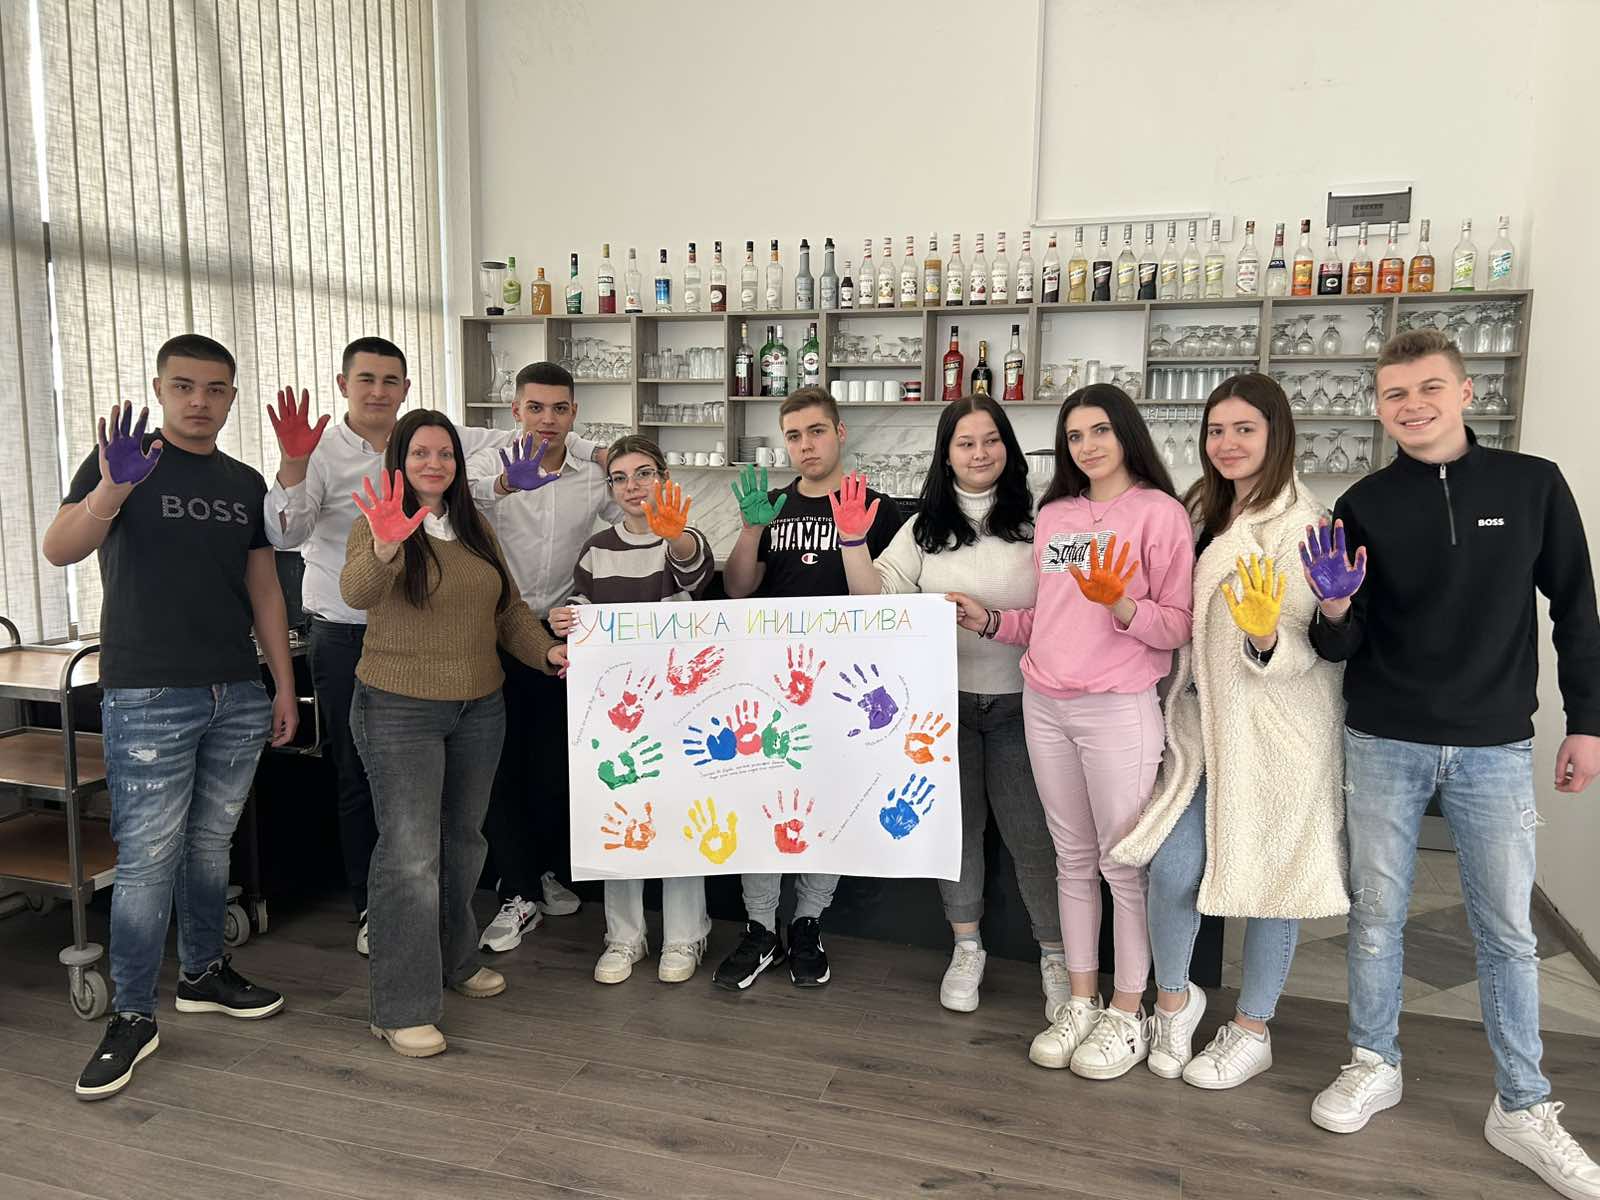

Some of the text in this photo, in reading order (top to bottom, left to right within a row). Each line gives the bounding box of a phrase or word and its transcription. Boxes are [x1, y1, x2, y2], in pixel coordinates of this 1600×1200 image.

[161, 495, 249, 525] BOSS
[1478, 518, 1505, 527] BOSS
[768, 522, 840, 552] CHAMPI
[575, 608, 913, 645] УЧЕНИЧКА ИНИЦИЈАТИВА
